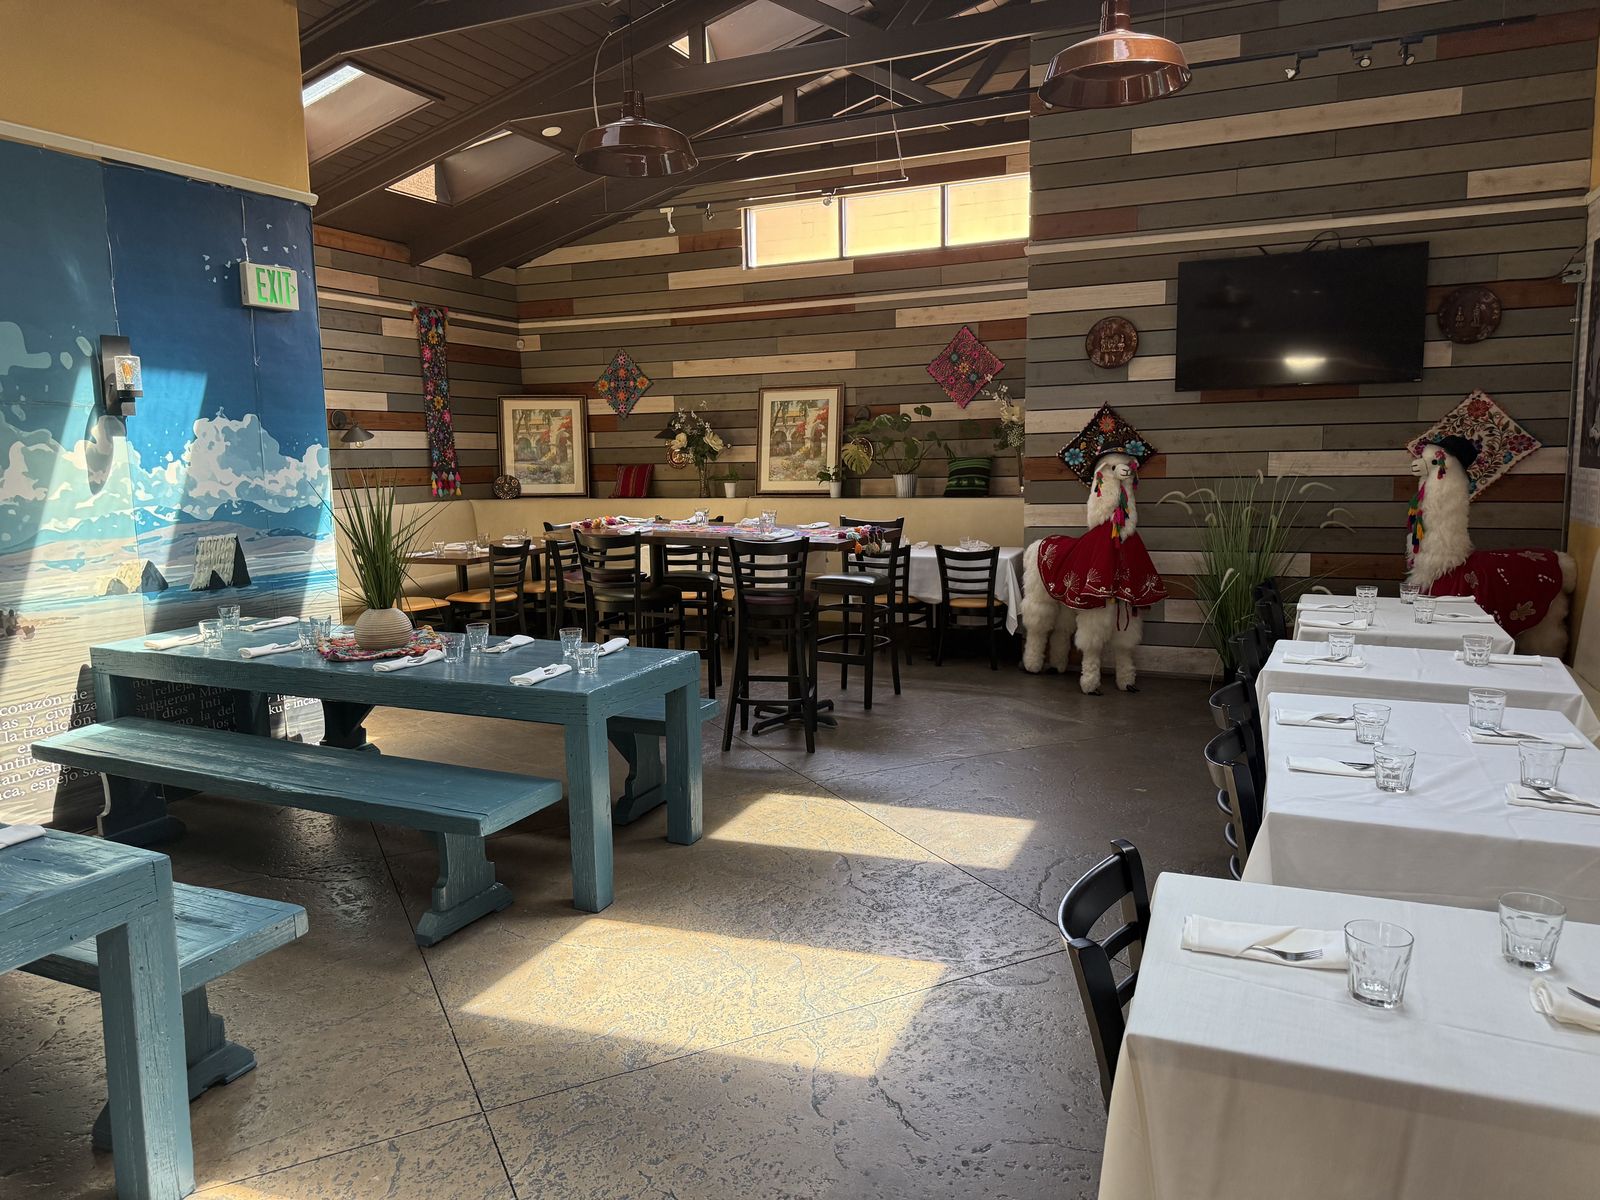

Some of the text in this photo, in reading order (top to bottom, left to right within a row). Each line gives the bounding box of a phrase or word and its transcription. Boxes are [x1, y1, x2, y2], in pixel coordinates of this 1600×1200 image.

[256, 267, 291, 305] EXIT
[0, 689, 88, 717] corazón de
[162, 706, 189, 719] dios
[0, 718, 19, 730] as
[27, 714, 36, 728] y
[0, 787, 25, 801] ca,
